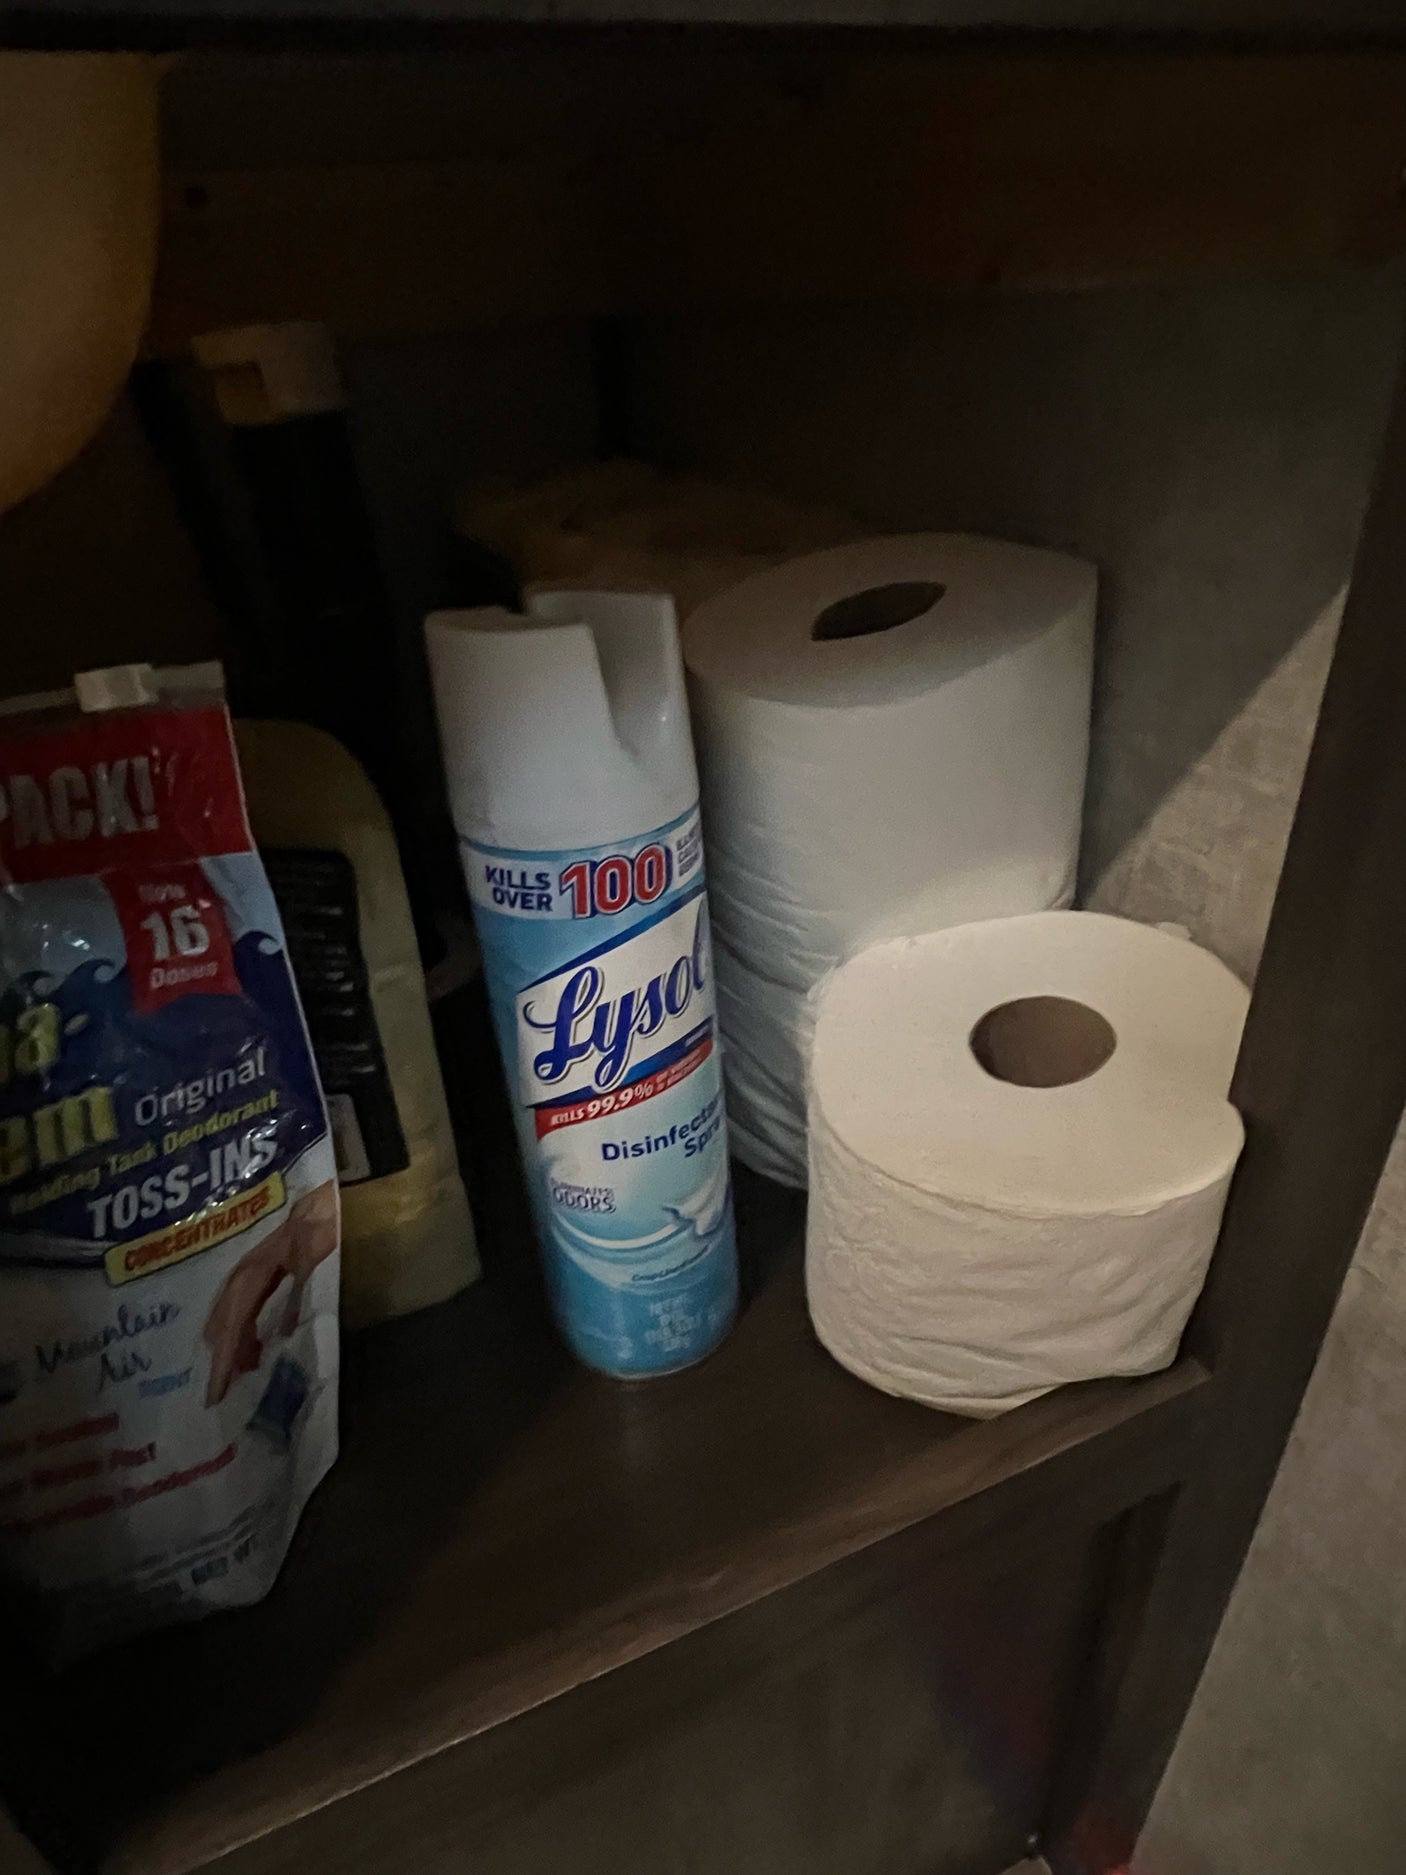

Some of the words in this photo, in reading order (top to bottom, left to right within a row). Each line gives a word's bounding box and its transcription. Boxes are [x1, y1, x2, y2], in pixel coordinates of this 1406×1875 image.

[0, 754, 160, 850] ACK!
[485, 865, 551, 891] KILLS
[493, 887, 553, 912] OVER
[558, 843, 673, 920] 100
[139, 904, 211, 961] 16
[523, 898, 705, 1090] Lysol
[134, 1045, 266, 1127] Original
[550, 1108, 585, 1127] KILLS
[586, 1081, 654, 1118] 99.9%
[162, 1088, 279, 1156] Deodorant
[86, 1128, 279, 1240] TOSS-INS
[552, 1187, 616, 1213] ODORS
